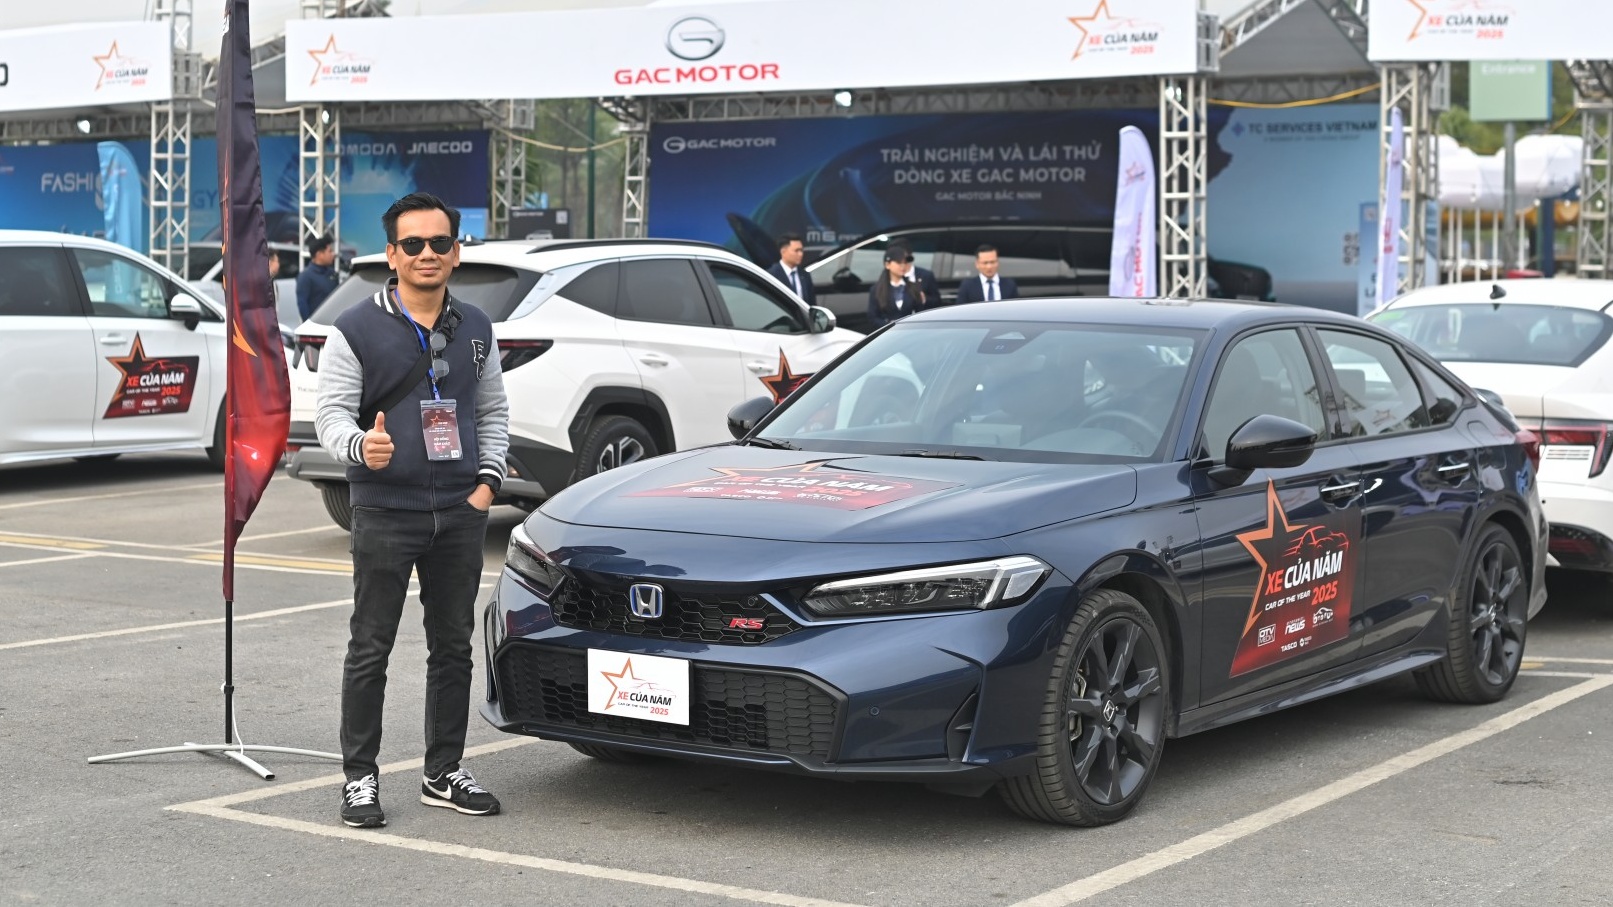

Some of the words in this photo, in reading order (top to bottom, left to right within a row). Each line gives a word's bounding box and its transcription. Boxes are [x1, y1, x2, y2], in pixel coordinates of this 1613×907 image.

[614, 69, 670, 85] GAC
[676, 63, 780, 83] MOTOR
[1266, 121, 1323, 133] SERVICES
[1325, 120, 1378, 132] VIETNAM
[687, 139, 718, 149] GAC
[720, 137, 777, 149] MOTOR
[881, 144, 919, 163] TRẢI
[925, 144, 994, 165] NGHIỆM
[894, 166, 945, 184] DÒNG
[950, 169, 973, 183] XE
[977, 168, 1014, 183] GAC
[1019, 167, 1086, 182] MOTOR
[126, 375, 139, 387] XE
[140, 372, 160, 387] CỦA
[161, 386, 181, 396] 2025
[1265, 570, 1284, 596] XE
[1284, 558, 1311, 590] CỦA
[1312, 550, 1343, 580] NĂM
[1265, 602, 1277, 611] CAR
[1277, 599, 1285, 607] OF
[1286, 595, 1296, 604] THE
[1296, 590, 1311, 601] YEAR
[1312, 580, 1338, 606] 2025
[729, 617, 766, 630] RS
[1281, 641, 1297, 652] TASCO
[617, 690, 629, 700] XE
[629, 691, 649, 703] CỦA
[649, 694, 672, 706] NĂM
[650, 706, 669, 716] 2025
